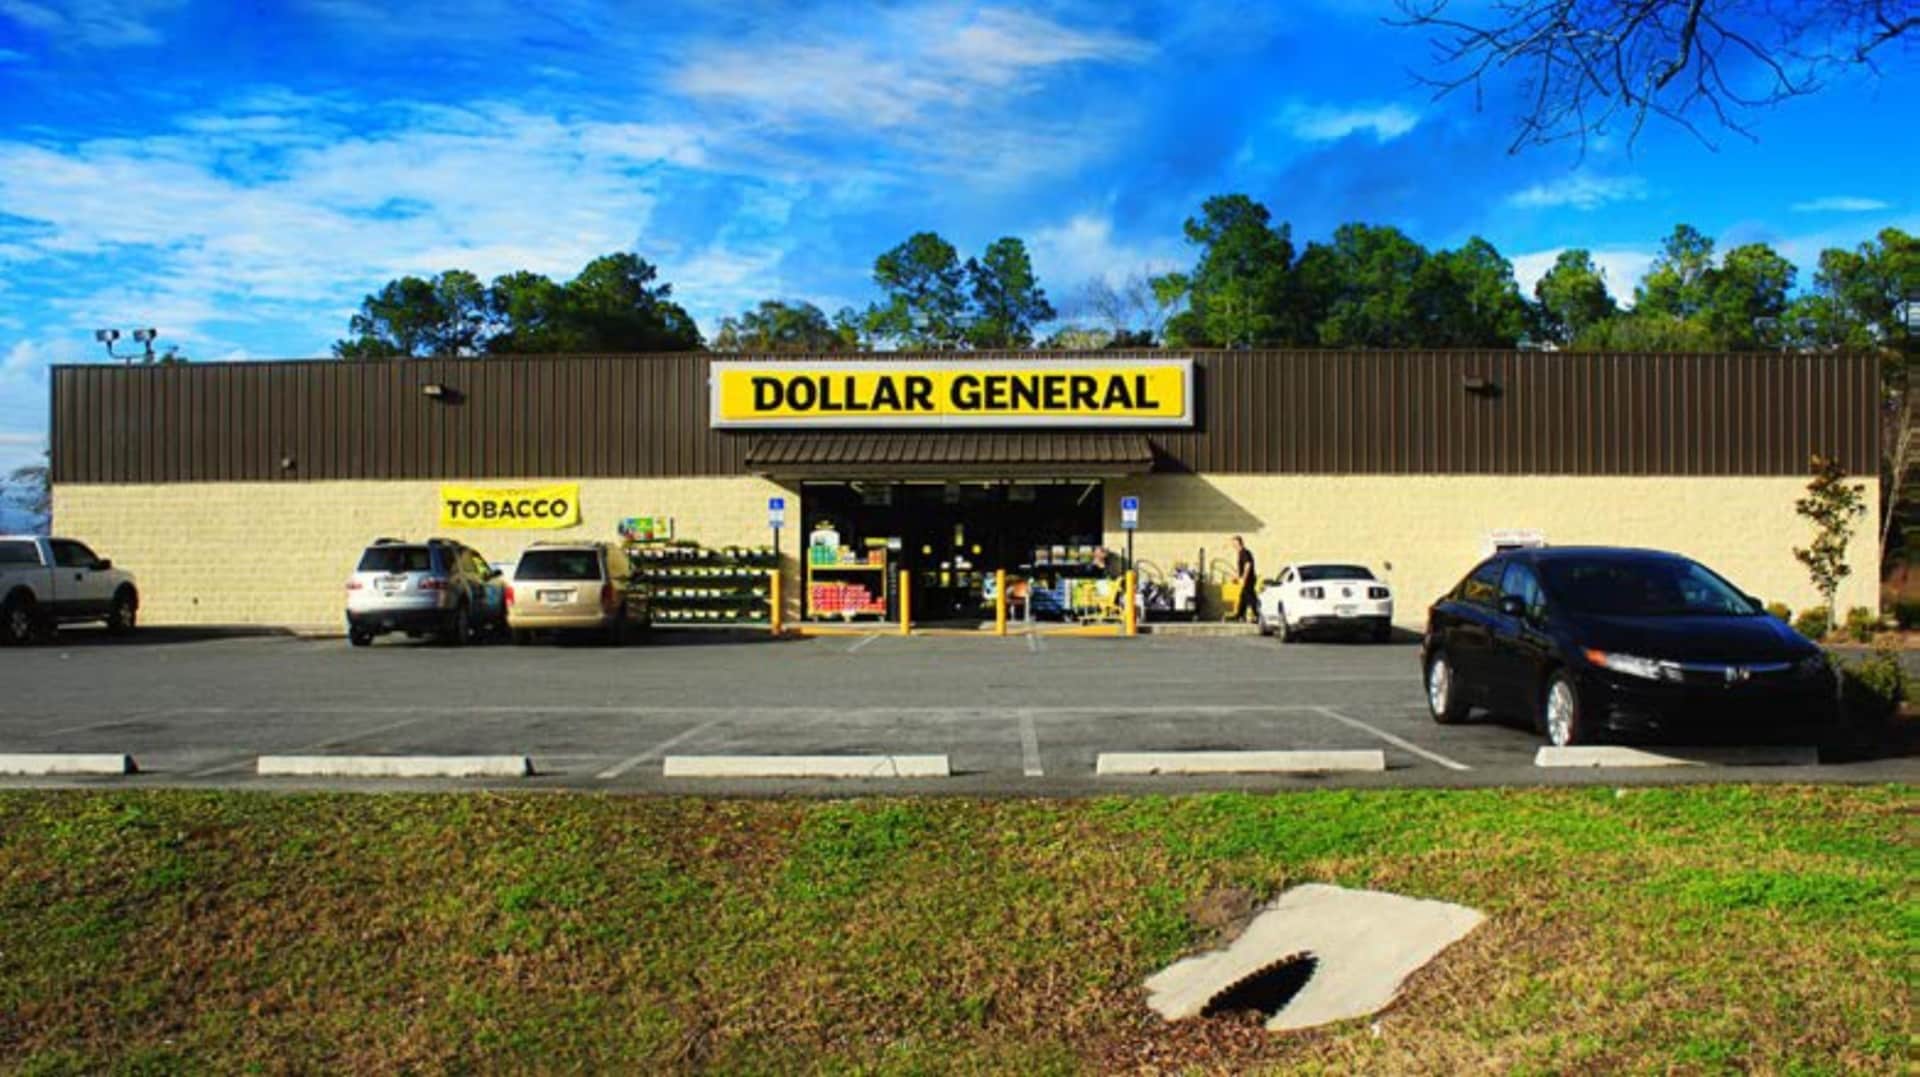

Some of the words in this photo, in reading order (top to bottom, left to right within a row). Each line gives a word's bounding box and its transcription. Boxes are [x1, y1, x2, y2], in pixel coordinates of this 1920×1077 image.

[752, 375, 934, 412] DOLLAR
[949, 374, 1160, 411] GENERAL
[447, 499, 568, 519] TOBACCO
